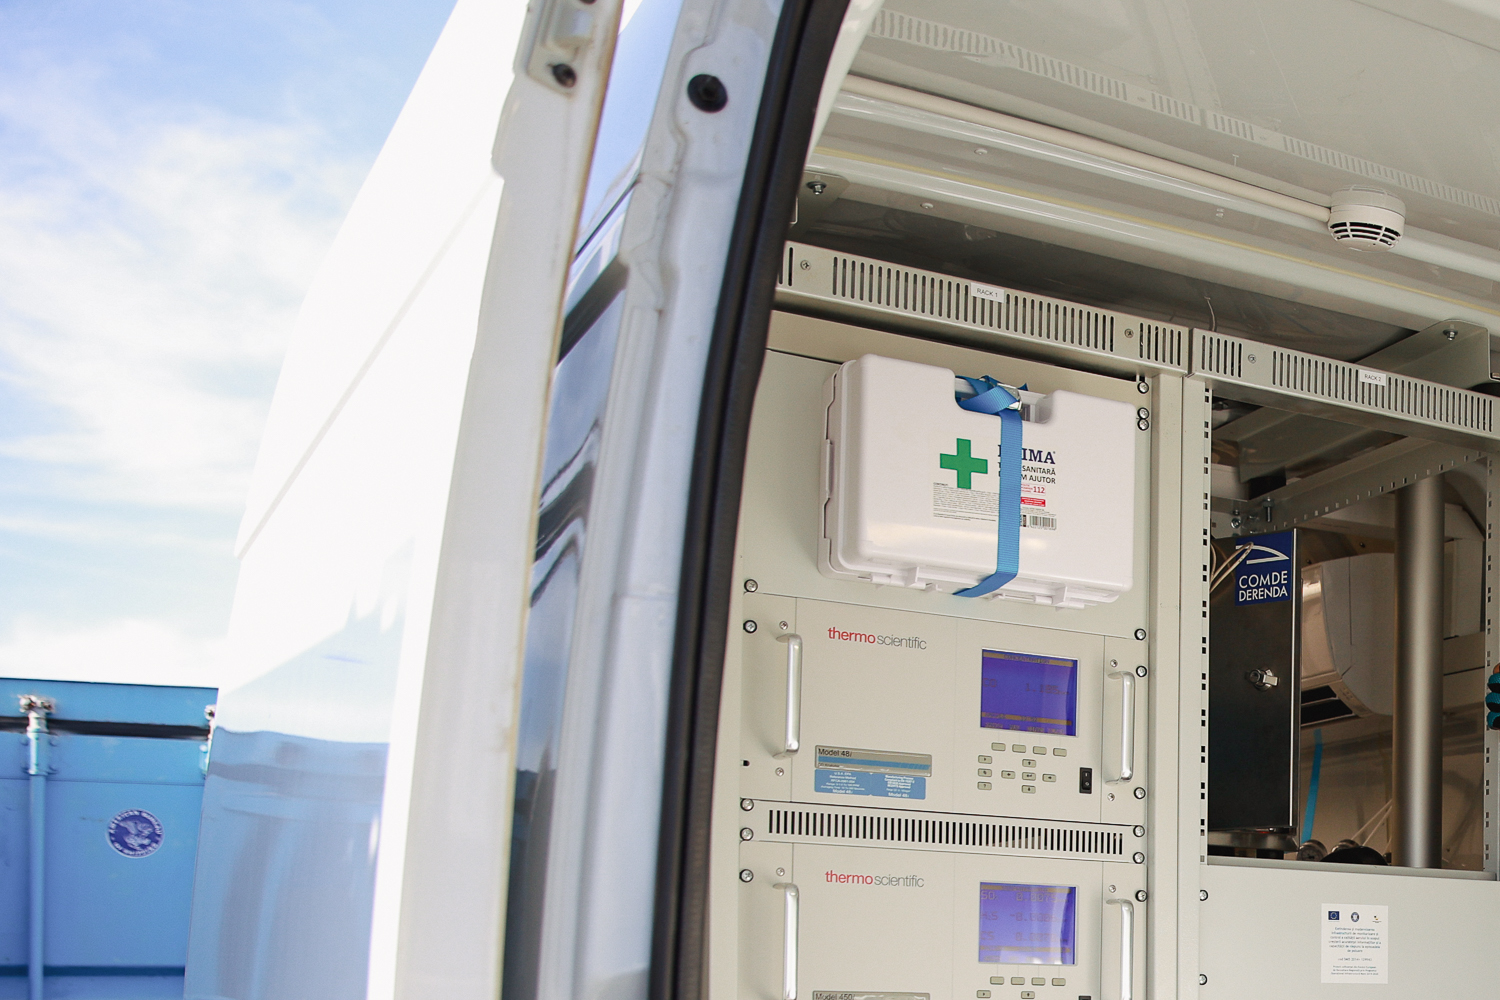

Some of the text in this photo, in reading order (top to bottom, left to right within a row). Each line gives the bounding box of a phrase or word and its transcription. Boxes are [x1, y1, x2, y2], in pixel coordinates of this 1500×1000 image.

[977, 288, 993, 297] RACK
[1365, 373, 1377, 381] RACK
[998, 444, 1056, 465] IMA
[1022, 465, 1056, 476] SANITARĂ
[1029, 475, 1056, 484] AJUTOR
[1239, 570, 1288, 589] COMDE
[1238, 586, 1288, 602] DERENDA
[827, 626, 927, 650] thermo scientific
[818, 748, 839, 756] Model
[825, 870, 924, 888] thermo scientific
[815, 993, 837, 1000] Model
